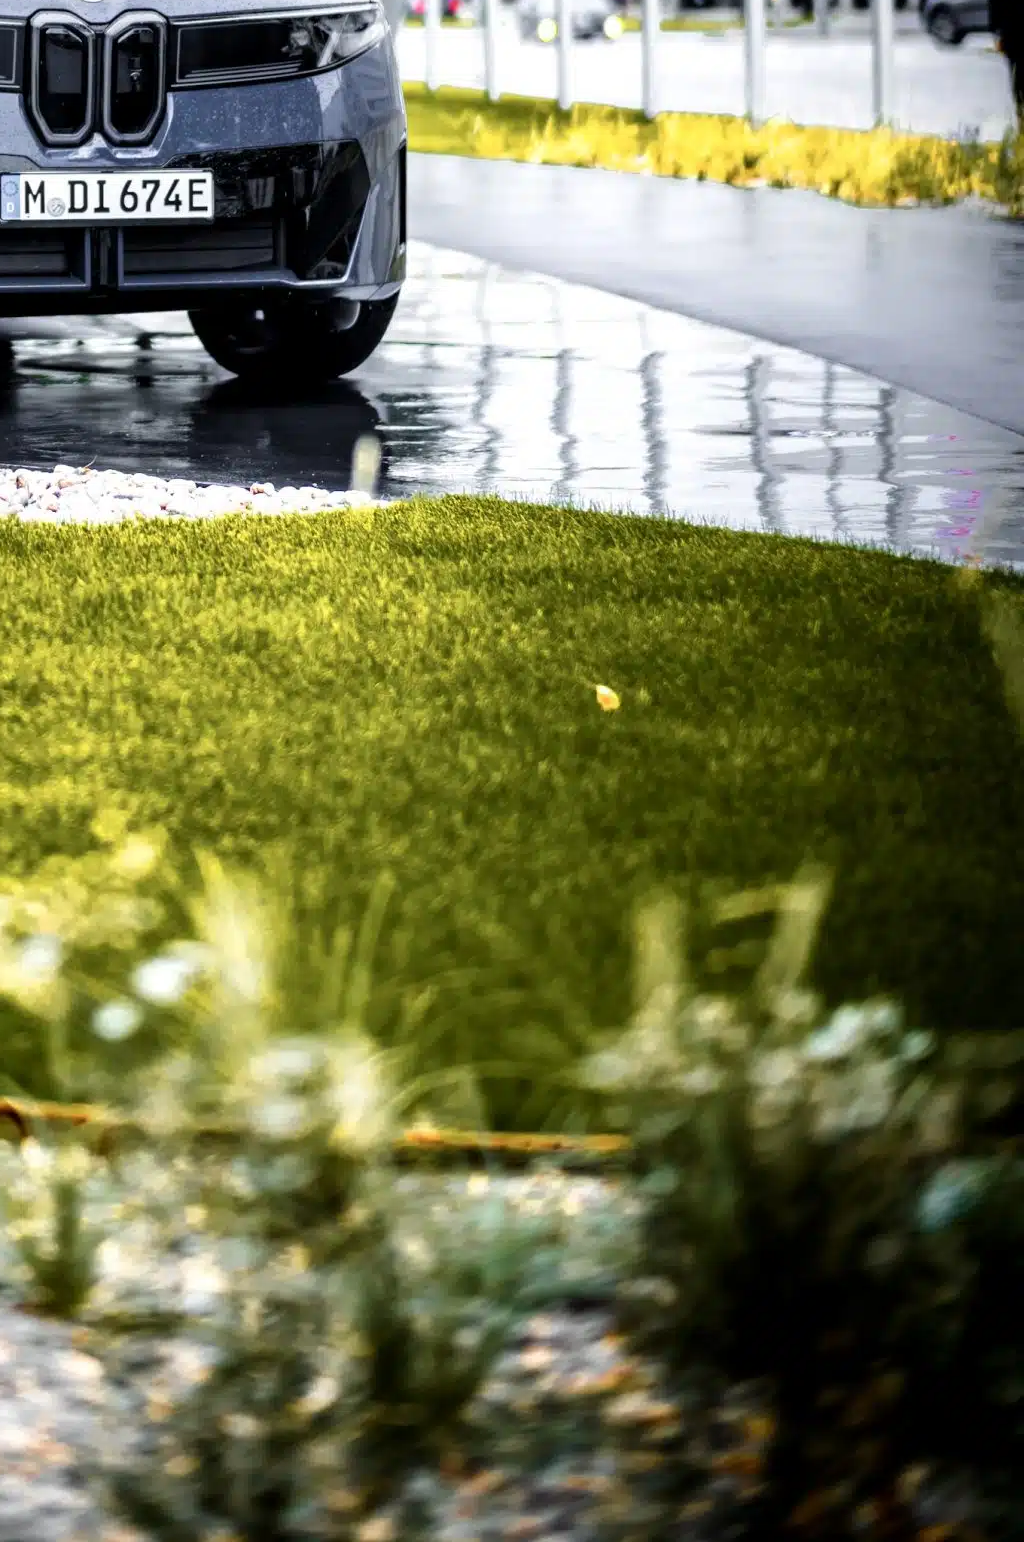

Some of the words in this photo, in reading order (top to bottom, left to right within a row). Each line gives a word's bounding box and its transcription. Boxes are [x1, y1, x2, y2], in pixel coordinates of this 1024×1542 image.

[24, 180, 46, 214] M
[67, 180, 111, 214] DI
[119, 178, 209, 213] 674E
